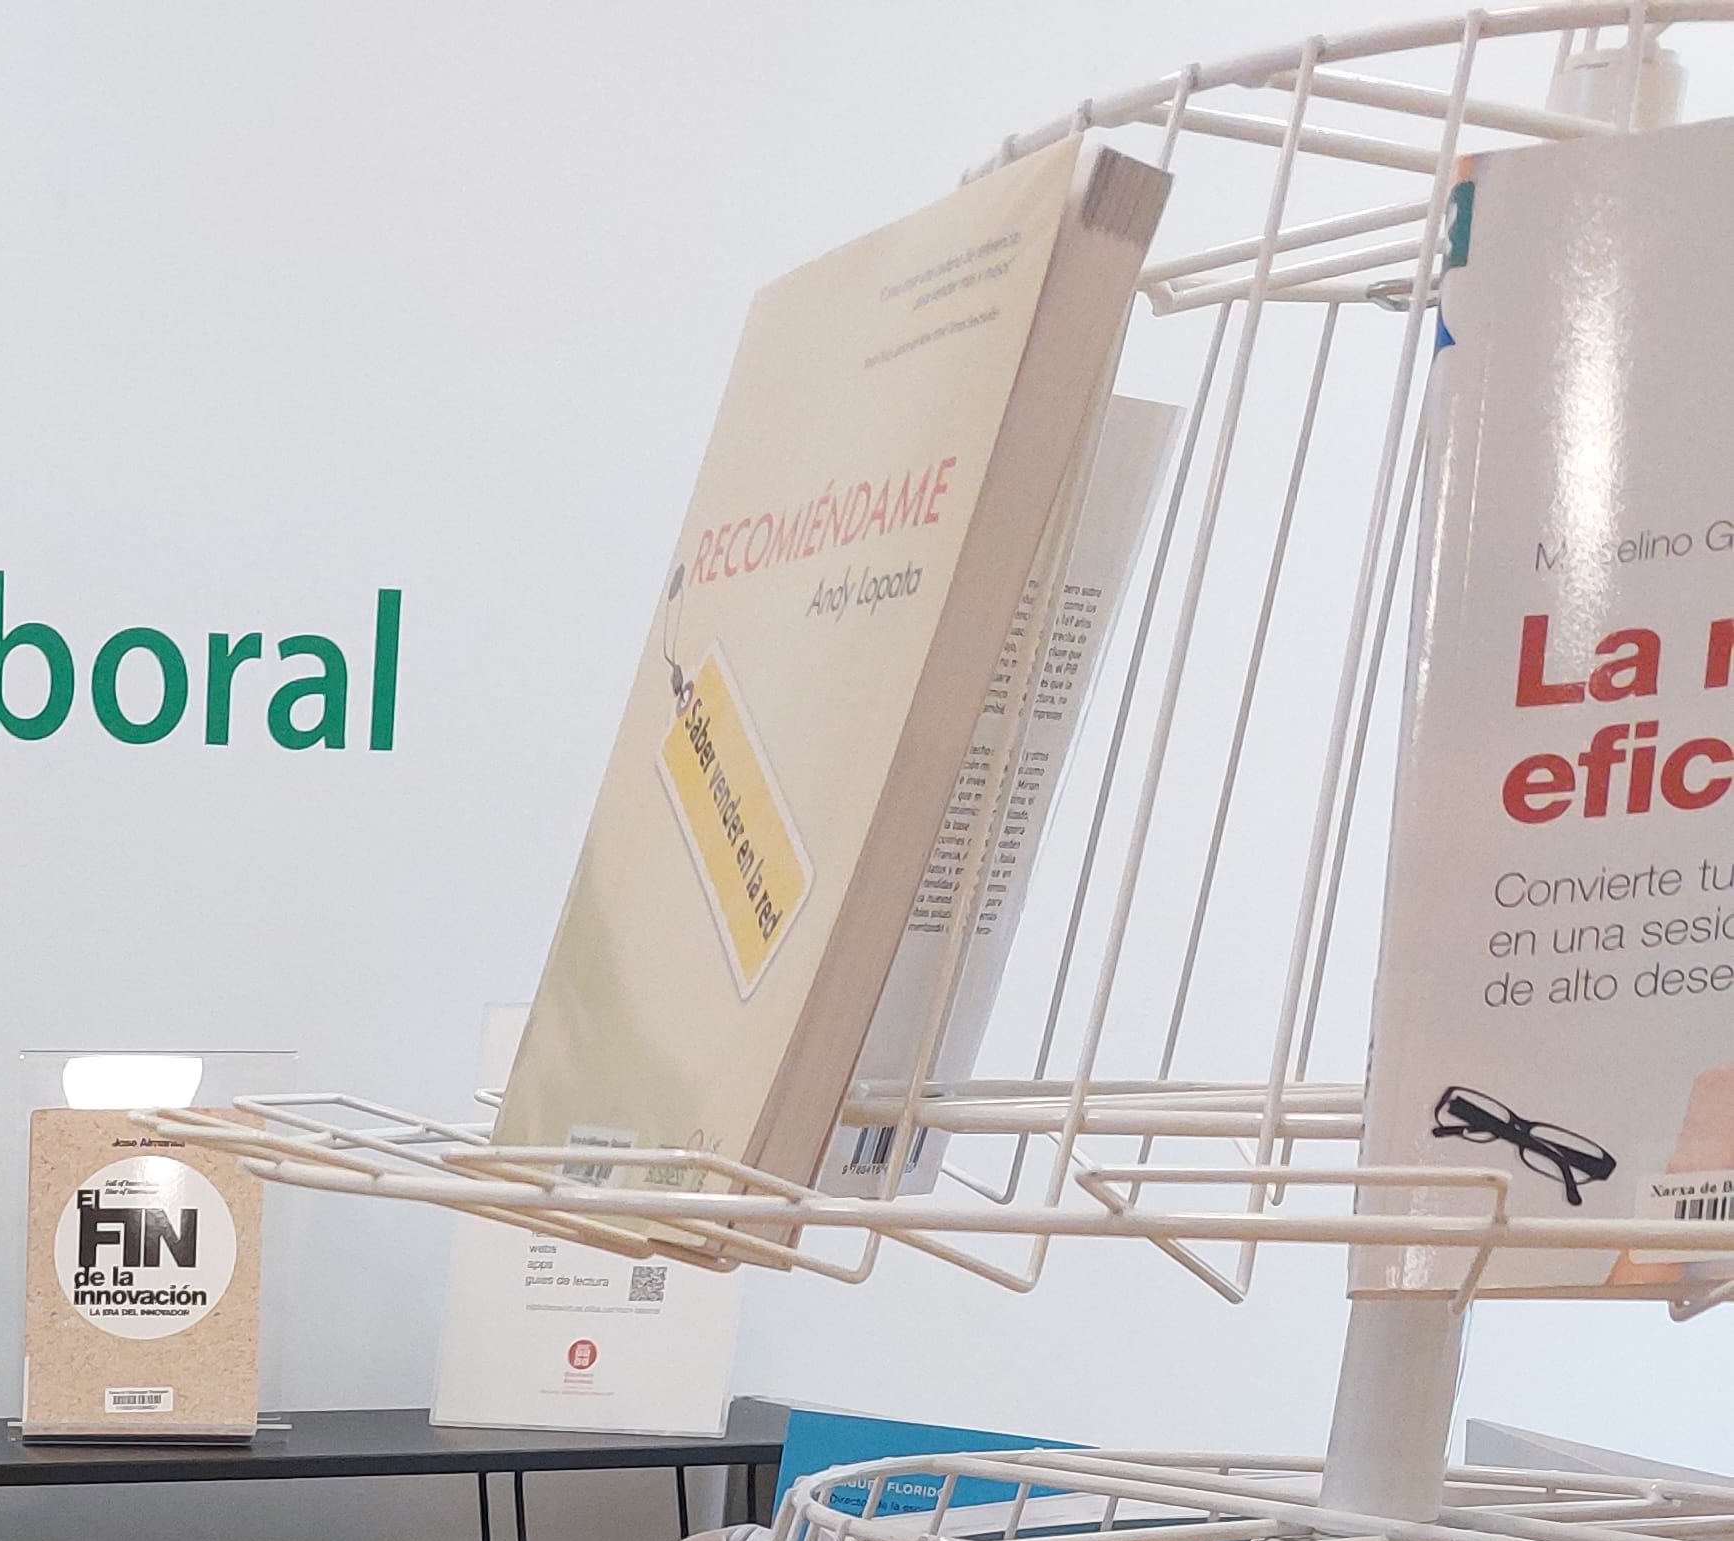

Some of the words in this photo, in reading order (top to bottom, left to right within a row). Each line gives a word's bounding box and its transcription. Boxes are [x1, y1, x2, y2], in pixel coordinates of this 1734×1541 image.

[688, 456, 958, 588] RECOMIÉNDAME
[806, 566, 854, 623] Andy
[856, 566, 924, 618] Lopata
[1515, 614, 1661, 707] La
[684, 697, 718, 775] Saber
[708, 760, 747, 845] vender
[737, 831, 754, 873] en
[757, 887, 786, 942] red
[1495, 864, 1682, 908] Convierte
[1488, 930, 1535, 958] en
[1553, 923, 1625, 955] una
[1484, 972, 1534, 1008] de
[1548, 968, 1618, 1003] alto
[76, 1189, 101, 1210] El
[77, 1207, 199, 1268] FIN
[73, 1284, 208, 1306] innovación
[74, 1266, 106, 1288] de
[111, 1266, 135, 1287] la
